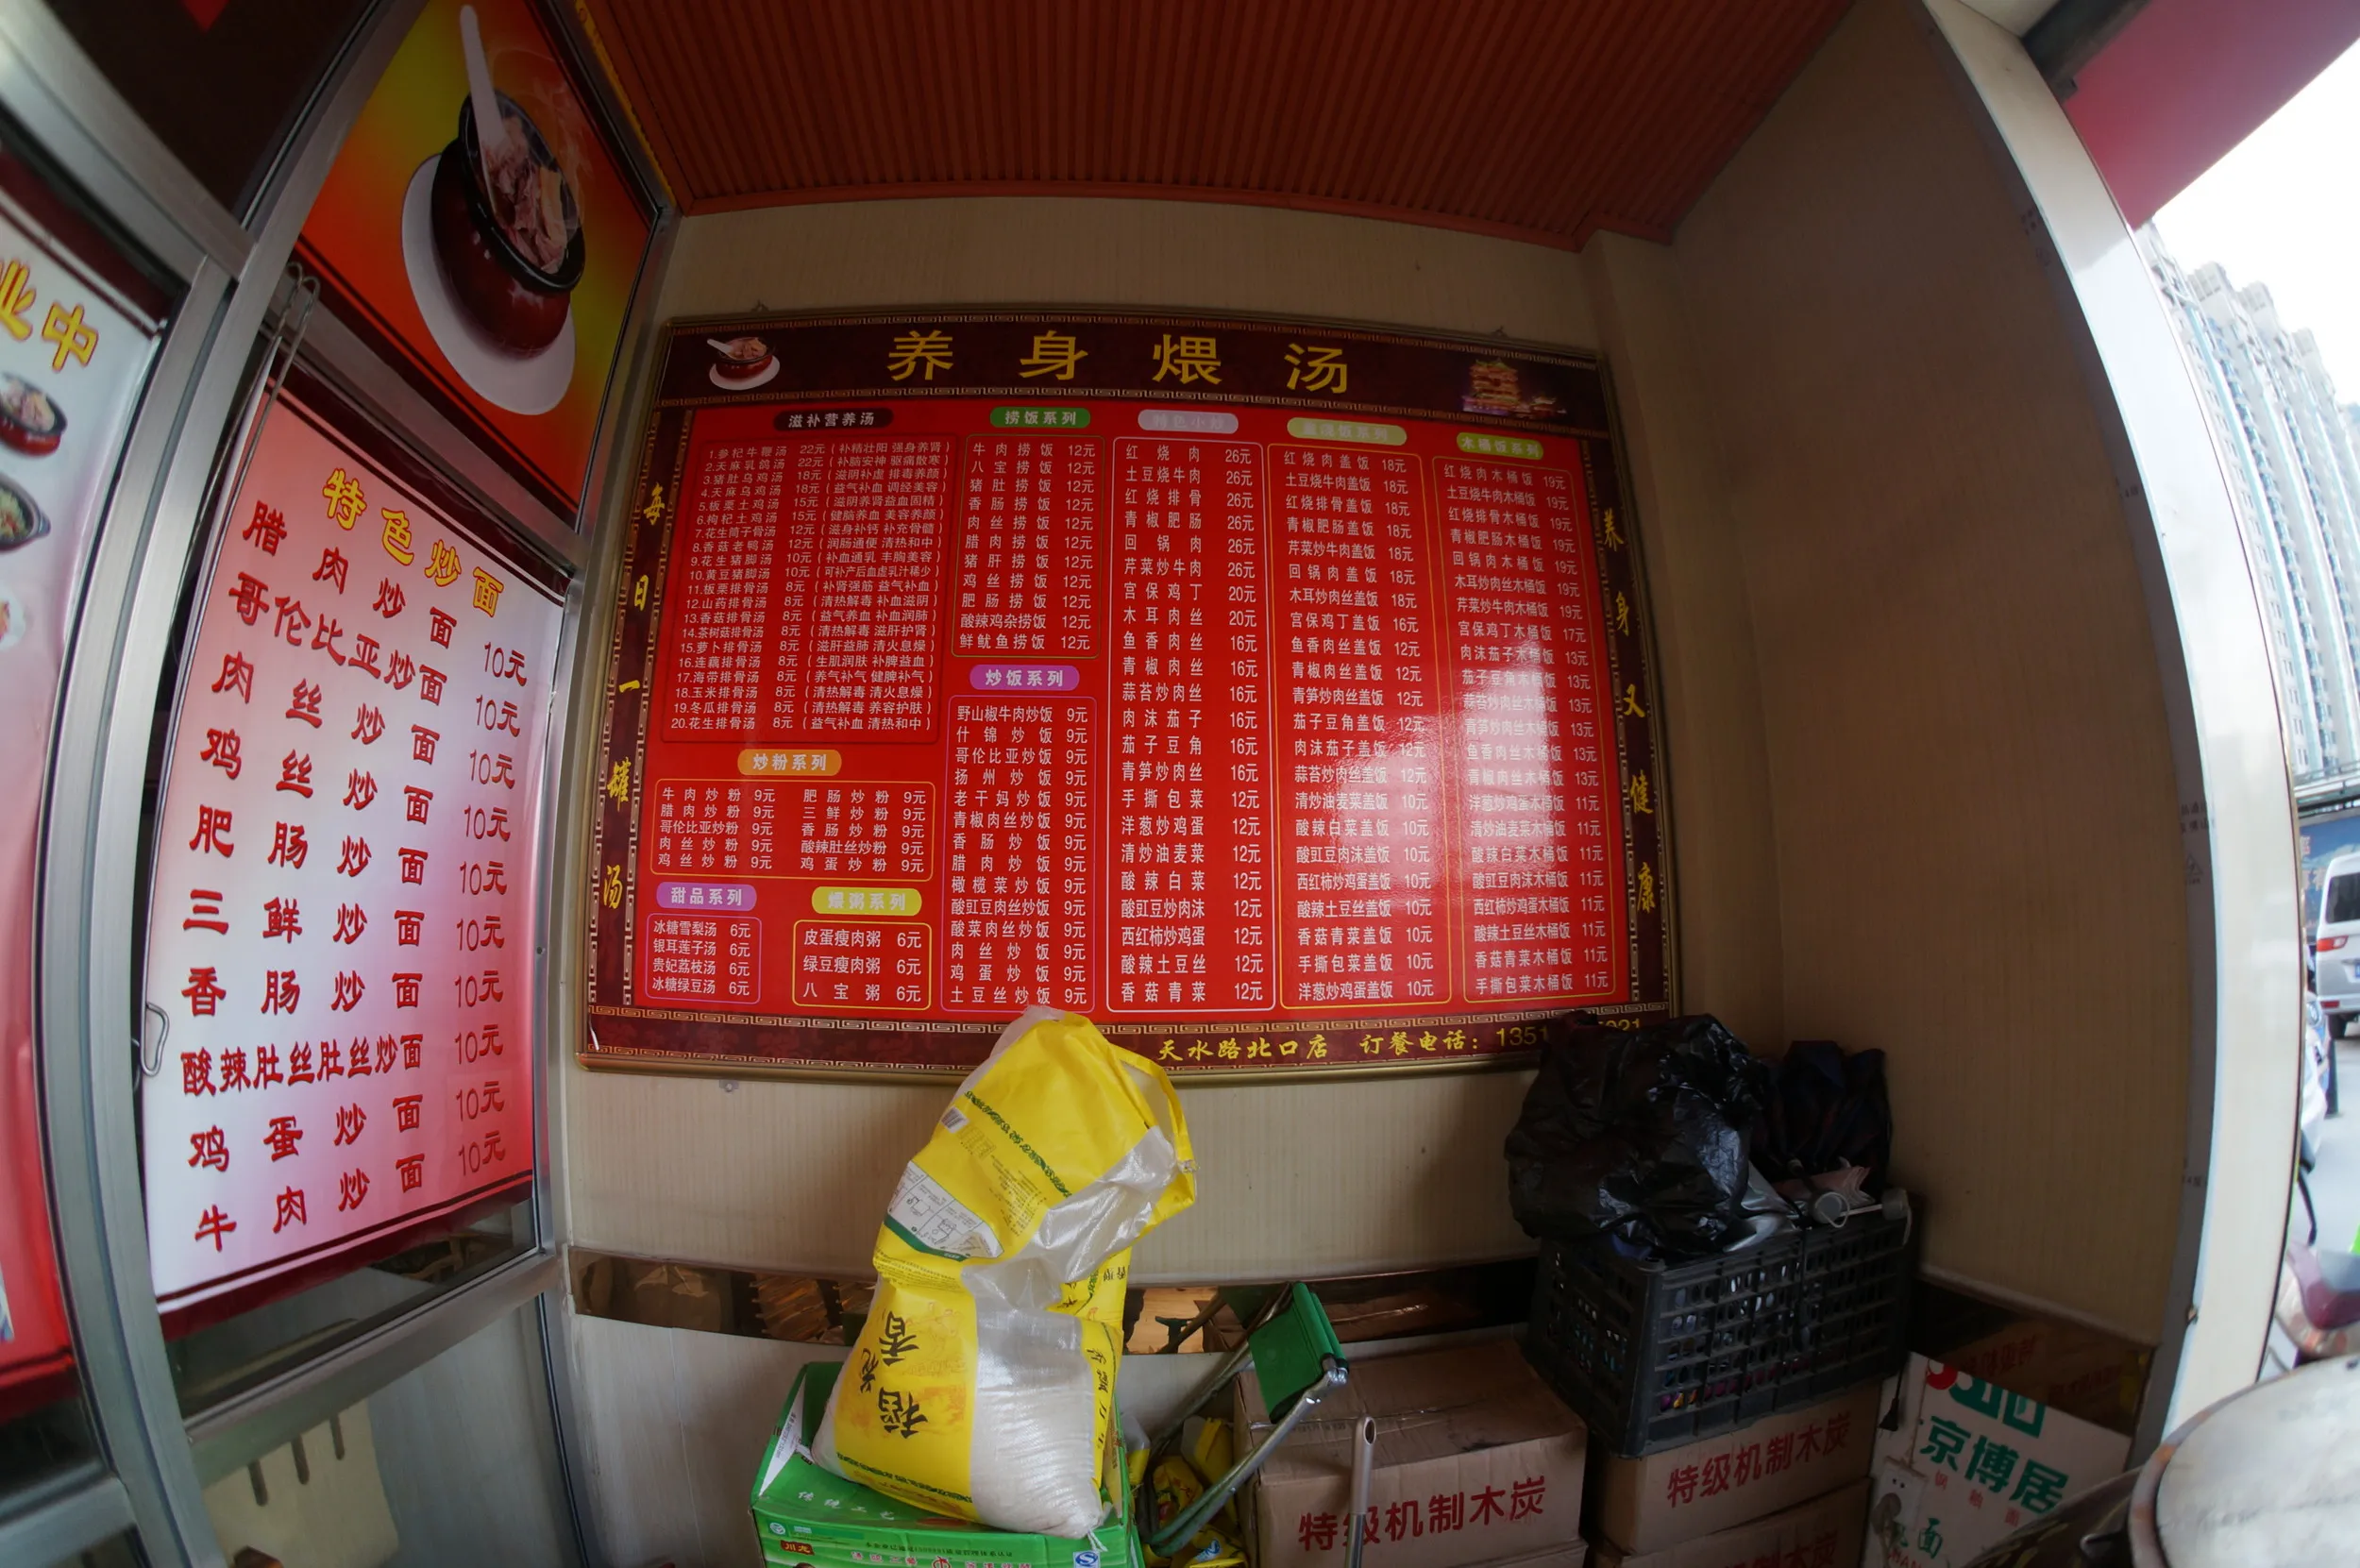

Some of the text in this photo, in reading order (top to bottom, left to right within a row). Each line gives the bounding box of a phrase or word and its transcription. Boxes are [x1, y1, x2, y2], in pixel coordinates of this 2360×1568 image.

[886, 329, 1349, 395] 养身煨汤
[788, 412, 875, 429] 滋补营养汤
[1004, 410, 1077, 426] 捞饭系列
[972, 442, 1095, 457] 牛肉捞饭 12元
[1126, 444, 1252, 464] 红烧肉 26元
[798, 457, 823, 467] 22元
[971, 460, 1095, 475] 八宝捞饭 12元
[1284, 450, 1407, 473] 红烧肉盖饭 18元
[1125, 465, 1253, 486] 土豆烧牛肉 26元
[699, 497, 818, 512] 5.板栗土鸡汤 15元
[969, 497, 1094, 512] 香肠捞饭 12元
[1447, 484, 1569, 511] 土豆烧牛肉木桶饭 19元
[1287, 516, 1412, 539] 青椒肥肠盖饭 18元
[322, 467, 505, 617] 特色炒面
[1125, 534, 1256, 555] 回锅肉 26元
[1450, 528, 1576, 553] 青椒肥肠木桶饭 19元
[690, 566, 810, 581] 10.黄豆猪脚汤 10元
[243, 499, 528, 686] 腊肉炒面 10元
[686, 595, 803, 609] 12.山药排骨汤 8元
[1124, 582, 1256, 602] 宫保鸡丁 20元
[684, 610, 802, 624] 13.香菇排骨汤 8元
[960, 613, 1091, 630] 酸辣鸡杂捞饭 12元
[1290, 612, 1419, 632] 宫保鸡丁盖饭 16元
[960, 633, 1090, 649] 鲜鱿鱼捞饭 12元
[1563, 628, 1586, 643] 17元
[228, 571, 521, 737] 哥伦比亚炒面 10元
[677, 670, 797, 683] 17.海带排骨汤 8元
[985, 670, 1064, 687] 炒饭系列
[676, 685, 795, 699] 18.玉米排骨汤 8元
[1122, 682, 1257, 703] 蒜苔炒肉丝 16元
[211, 650, 515, 789] 肉丝炒面 10元
[957, 705, 1087, 723] 野山椒牛肉炒饭 9元
[1603, 508, 1656, 914] 养身又健康
[671, 717, 793, 730] 20.花生排骨汤 8元
[956, 726, 1087, 744] 什锦炒饭 9元
[752, 753, 827, 771] 炒粉系列
[955, 747, 1087, 765] 哥伦比亚炒饭 9元
[200, 727, 512, 843] 鸡丝炒面 10元
[954, 768, 1087, 786] 扬州炒饭 9元
[662, 786, 775, 802] 牛肉炒粉 9元
[803, 789, 926, 804] 肥肠炒粉 9元
[954, 789, 1087, 807] 老干妈炒饭 9元
[1121, 788, 1259, 809] 手撕包菜 12元
[660, 819, 773, 835] 哥伦比亚炒粉 9元
[189, 803, 507, 895] 肥肠炒面 10元
[801, 839, 924, 855] 酸辣肚丝炒粉 9元
[658, 852, 772, 869] 鸡丝炒粉 9元
[801, 856, 924, 872] 鸡蛋炒粉 9元
[952, 876, 1086, 894] 橄榄菜炒饭 9元
[1297, 871, 1431, 890] 西红柿炒鸡蛋盖饭 10元
[1471, 869, 1604, 889] 酸豇豆肉沫木桶饭 11元
[671, 887, 742, 905] 甜品系列
[1121, 898, 1262, 919] 酸豇豆炒肉沫 12元
[183, 889, 505, 951] 三鲜炒面 10元
[653, 919, 750, 938] 冰糖雪梨汤 6元
[804, 928, 921, 948] 皮蛋瘦肉粥 6元
[1298, 925, 1433, 946] 香菇青菜盖饭 10元
[653, 938, 750, 957] 银耳莲子汤 6元
[653, 957, 750, 976] 贵妃荔枝汤 6元
[803, 955, 921, 975] 绿豆瘦肉粥 6元
[180, 967, 503, 1016] 香肠炒面 10元
[652, 976, 750, 996] 冰糖绿豆汤 6元
[802, 982, 921, 1002] 八宝粥 6元
[1121, 981, 1263, 1003] 香菇青菜 12元
[1299, 979, 1434, 1001] 洋葱炒鸡蛋盖饭 10元
[1475, 971, 1609, 995] 手撕包菜木桶饭 11元
[1157, 1033, 1329, 1061] 天水路北口店
[180, 1024, 503, 1097] 酸辣肚丝肚丝炒面 10元
[188, 1081, 505, 1172] 鸡蛋炒面 10元
[194, 1130, 506, 1252] 牛肉炒面 10元
[1667, 1411, 1851, 1508] 特级机制木炭
[1920, 1415, 2070, 1515] 京博居
